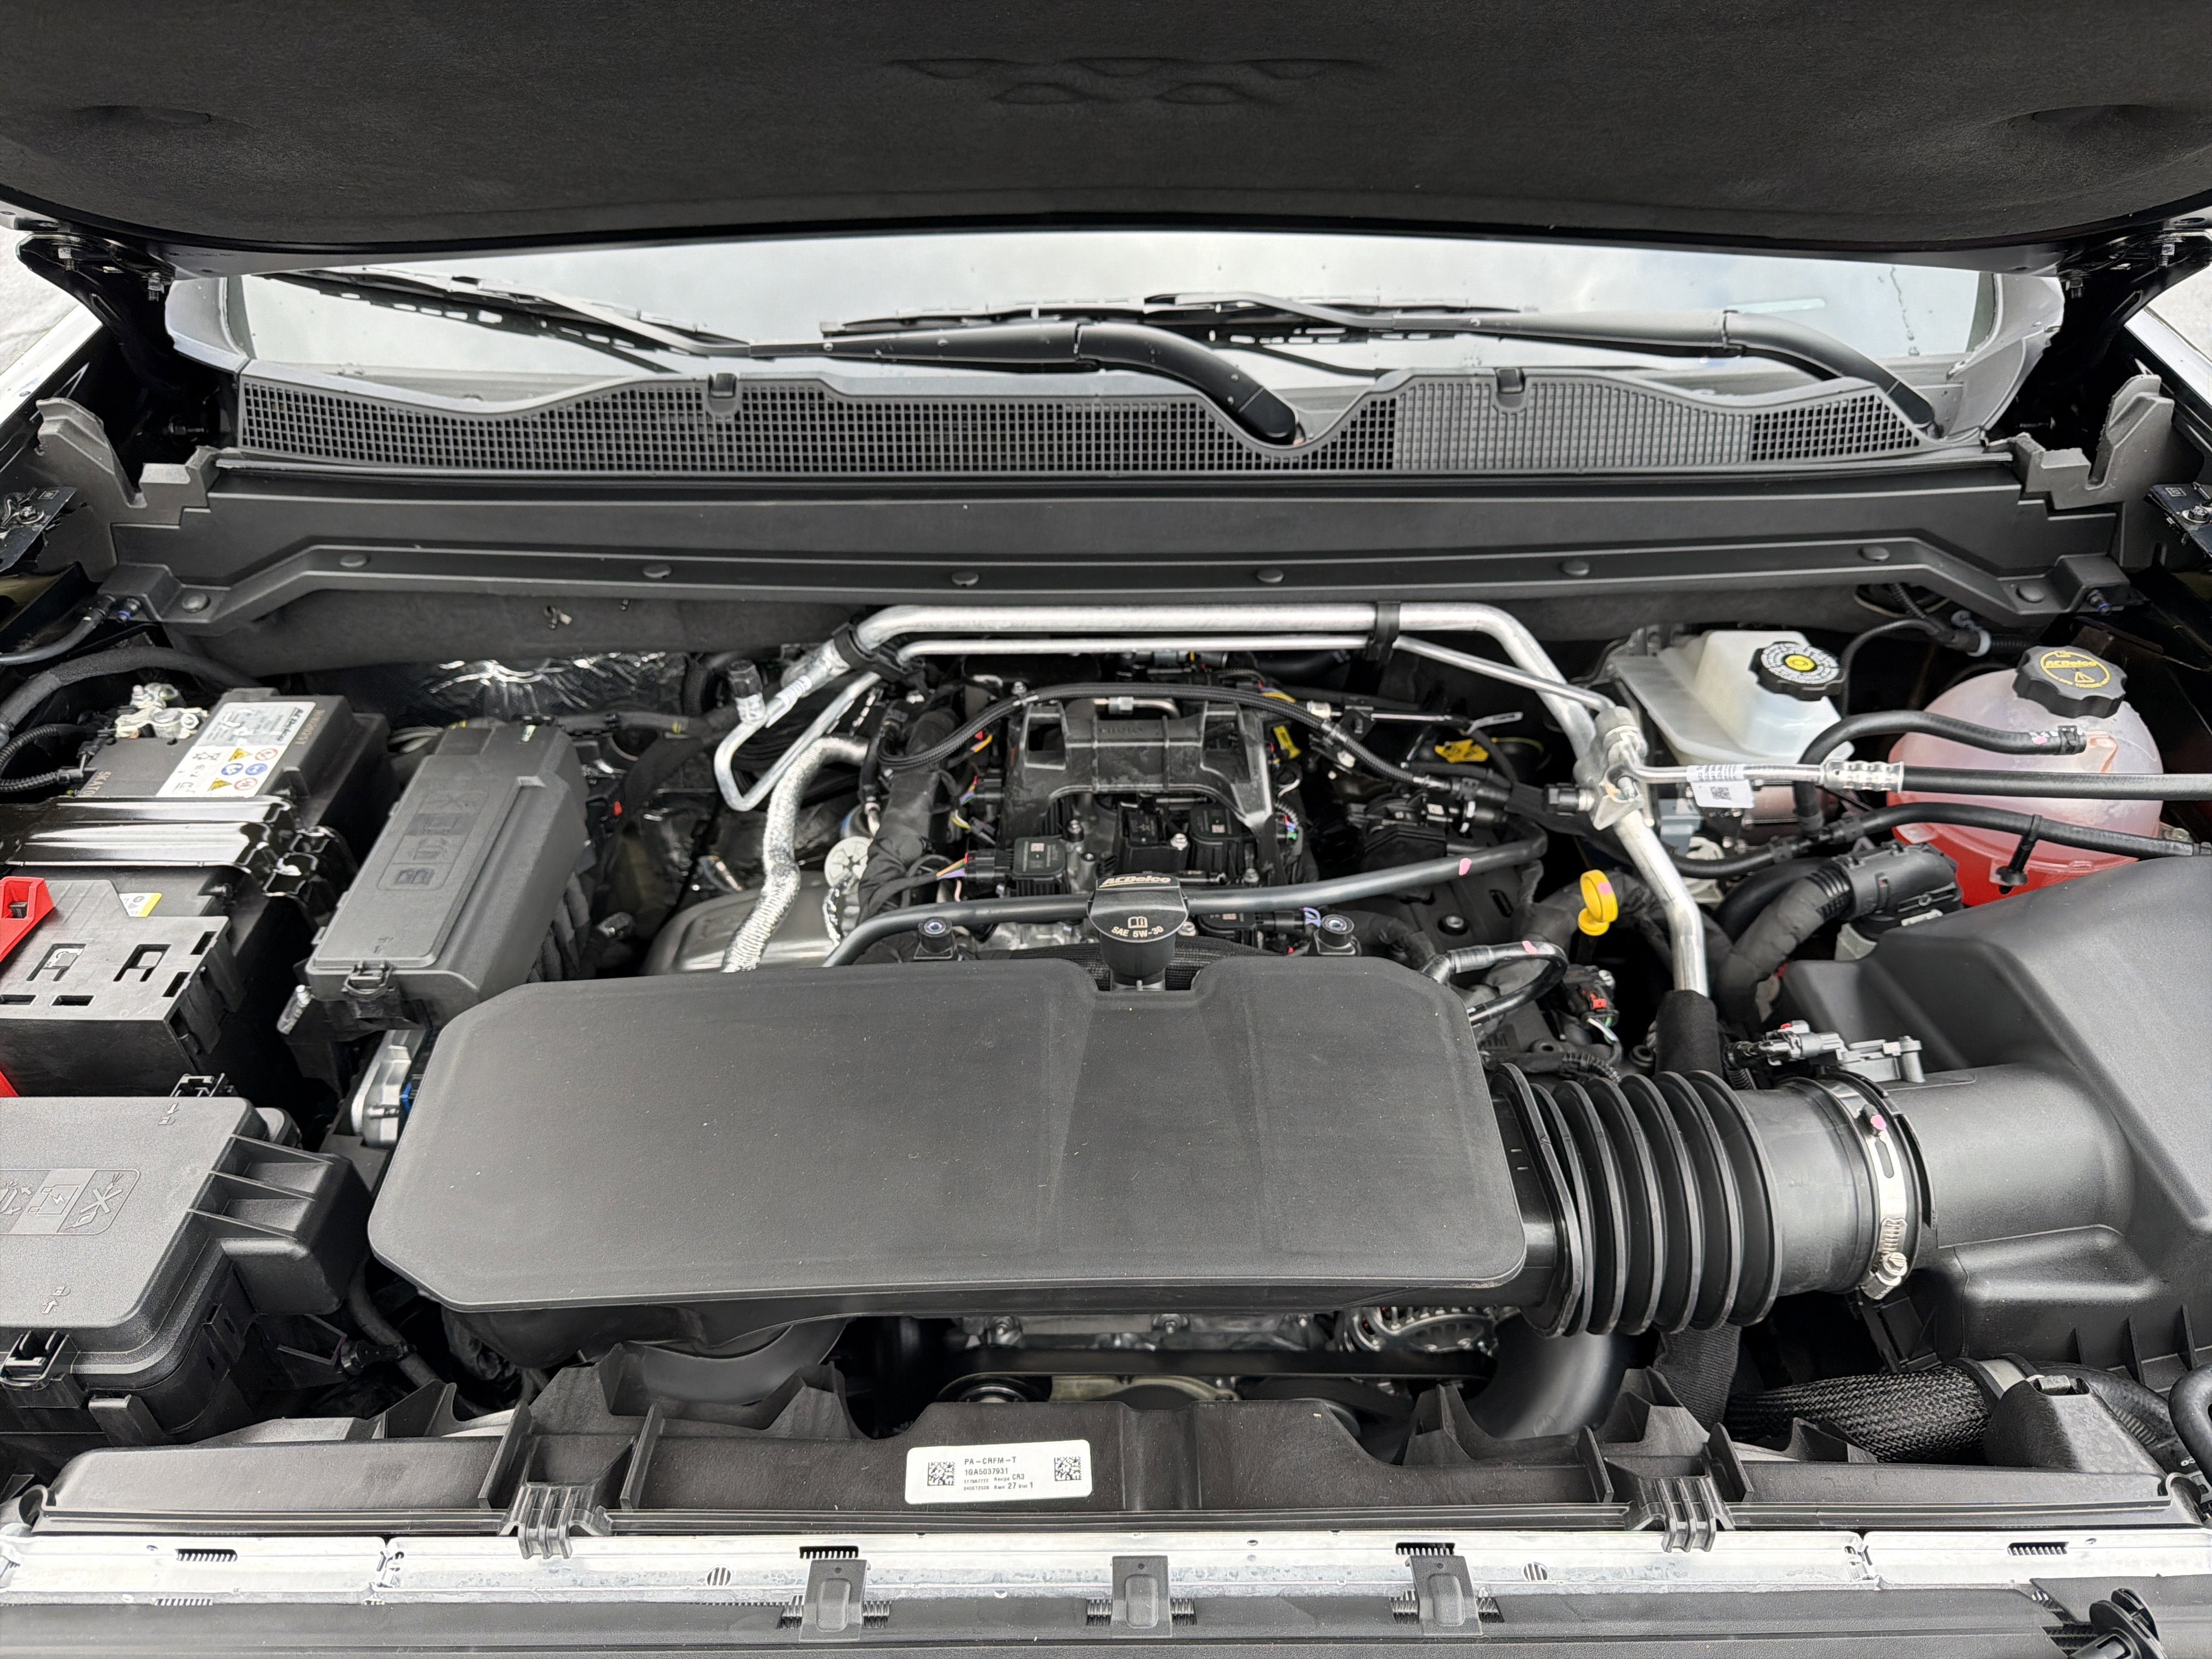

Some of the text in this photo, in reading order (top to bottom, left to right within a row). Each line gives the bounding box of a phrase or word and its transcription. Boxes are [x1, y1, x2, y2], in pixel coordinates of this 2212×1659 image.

[1102, 876, 1171, 885] ACDelco
[1111, 926, 1164, 938] SAE 5W-30
